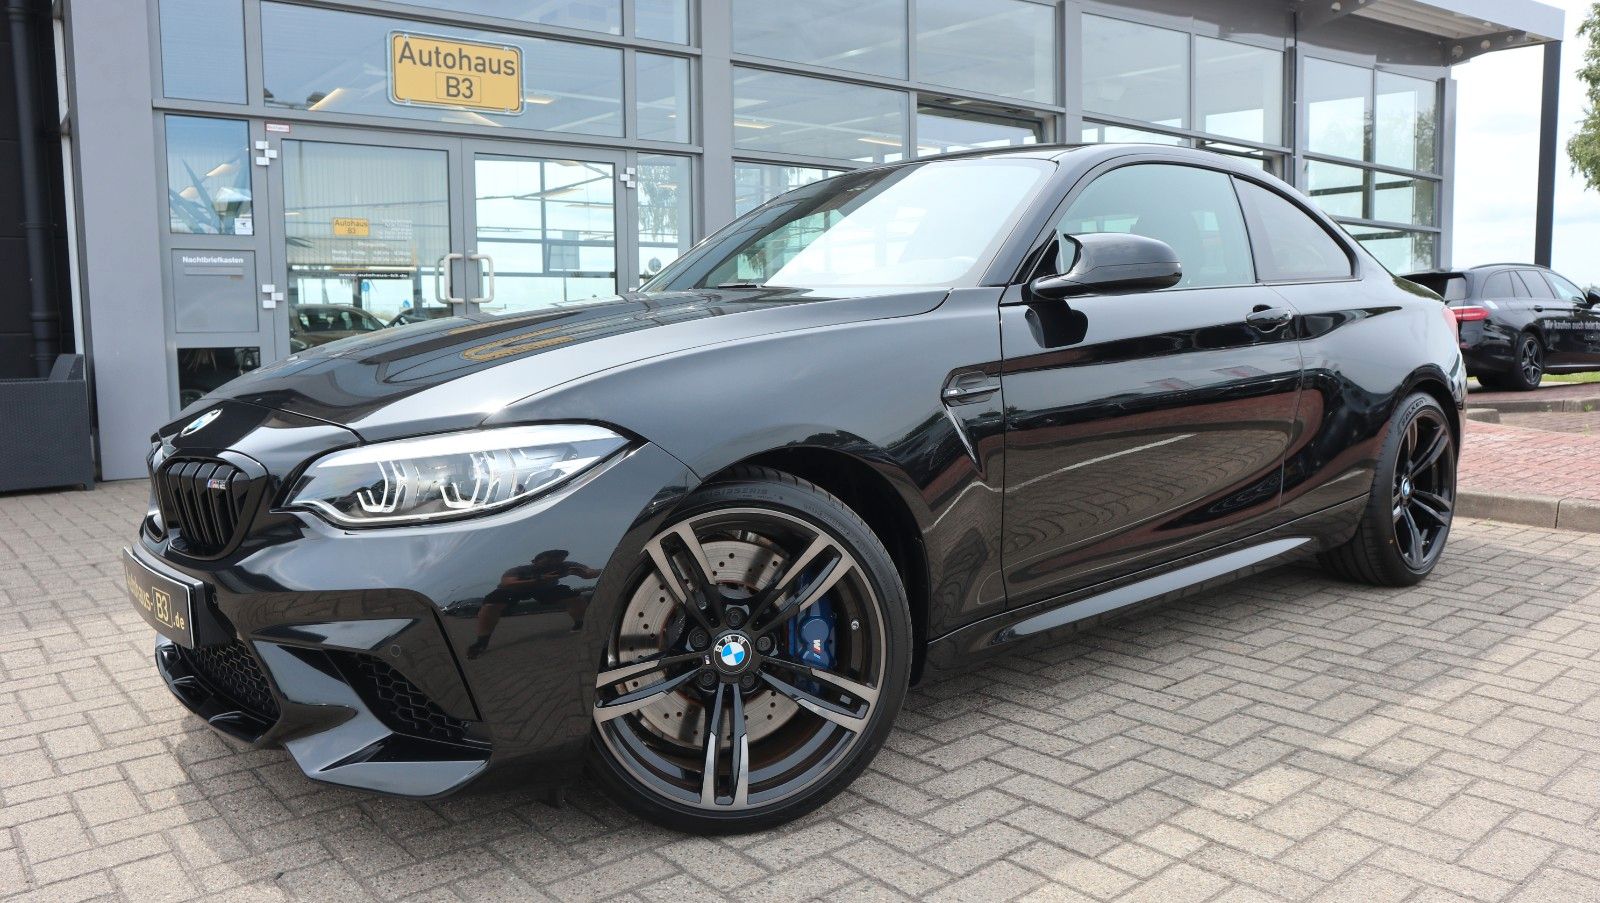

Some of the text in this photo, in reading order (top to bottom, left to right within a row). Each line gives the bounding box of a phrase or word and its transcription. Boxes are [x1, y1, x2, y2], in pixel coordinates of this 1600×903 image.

[398, 41, 515, 76] Autohaus
[445, 76, 473, 98] B3
[335, 219, 368, 228] Autohaus
[182, 256, 244, 264] Nachtbriefkasten
